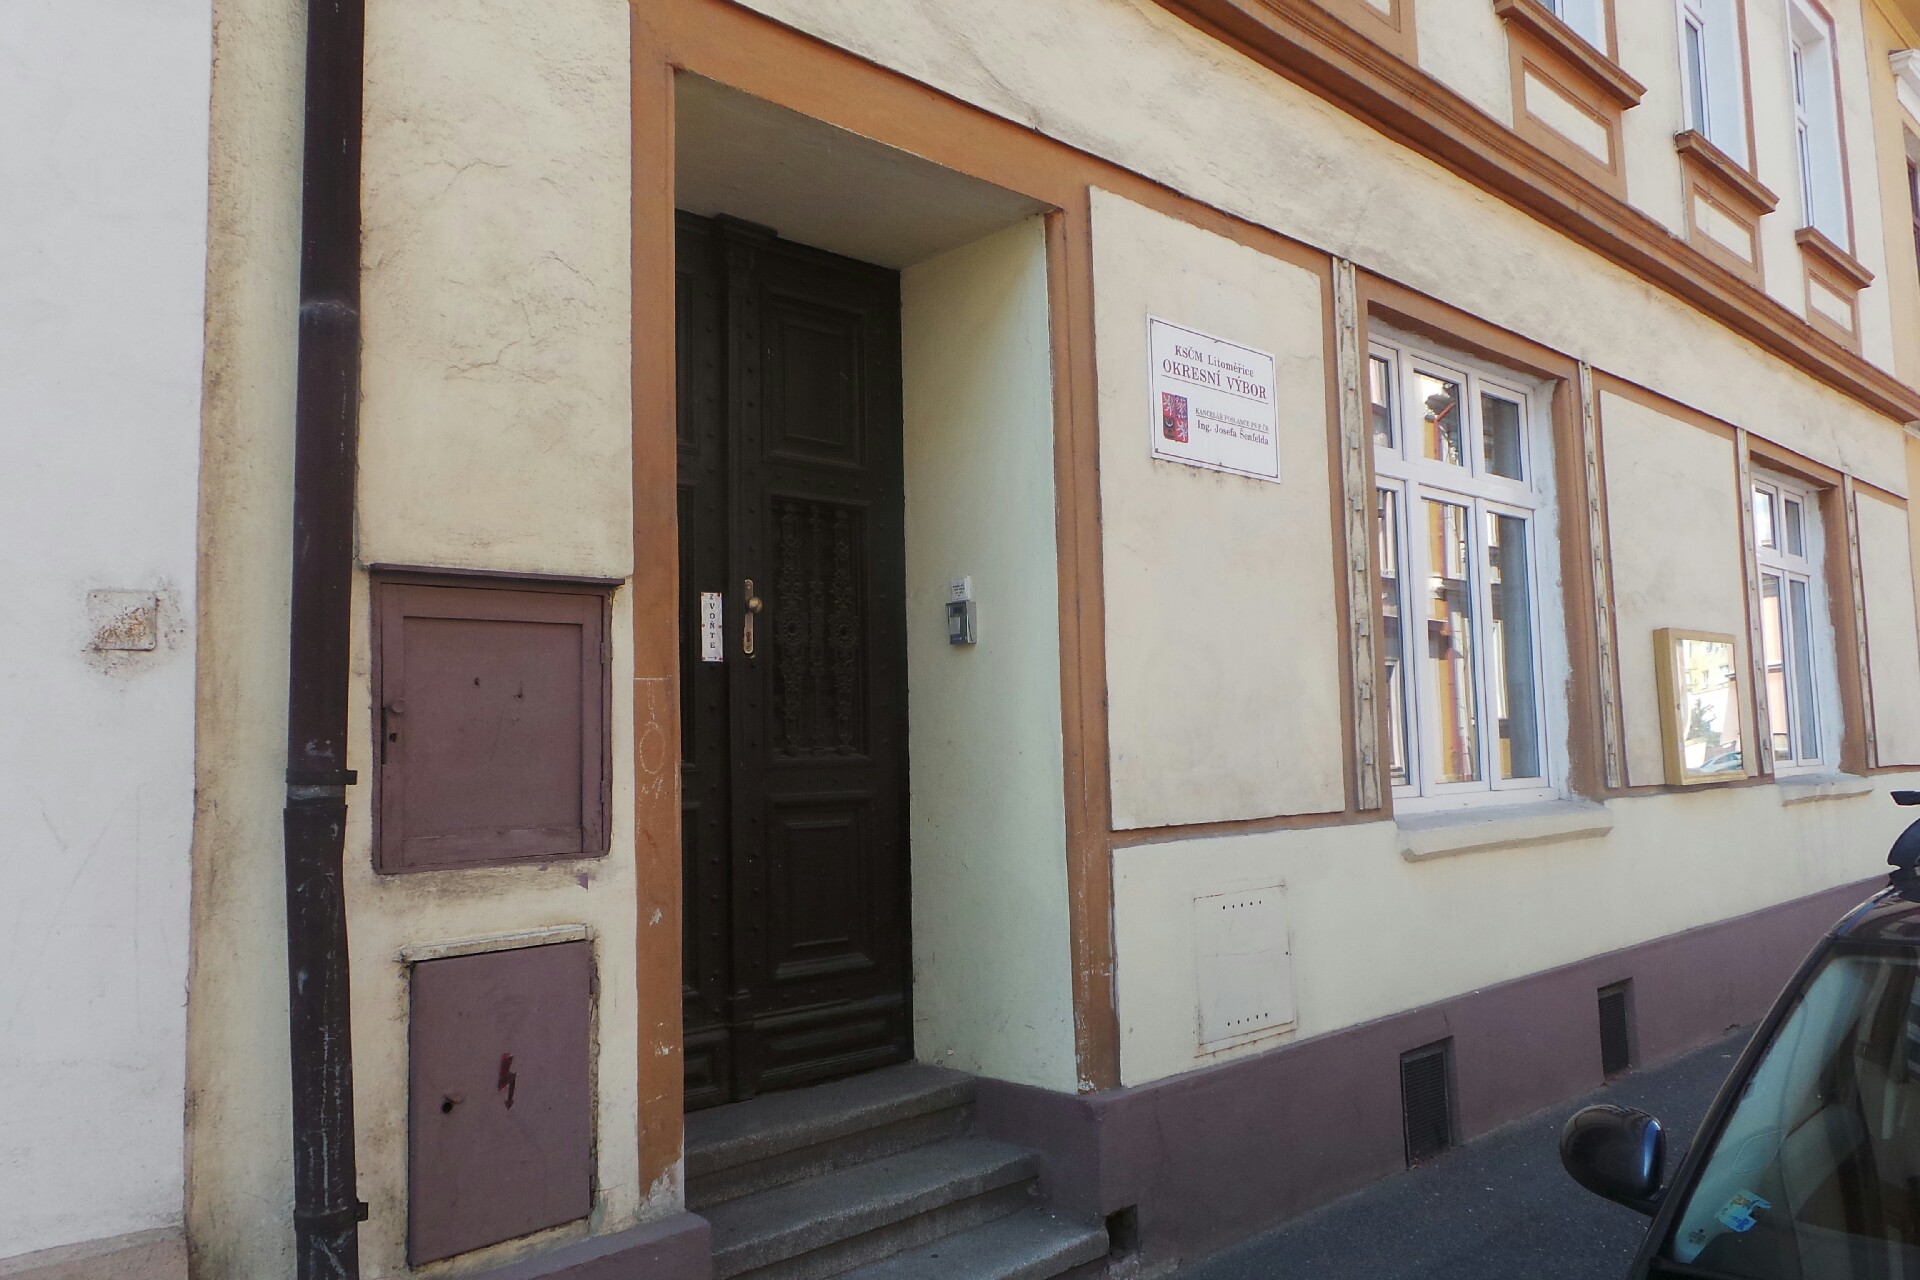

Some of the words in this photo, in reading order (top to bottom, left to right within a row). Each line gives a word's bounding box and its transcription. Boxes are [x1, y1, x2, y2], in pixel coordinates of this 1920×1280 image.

[1175, 345, 1203, 363] KSČM
[1208, 355, 1254, 377] Litoměřice
[1163, 358, 1221, 386] OKRESNÍ
[1226, 376, 1267, 399] VÝBOR
[1197, 419, 1212, 433] Ing.
[1215, 424, 1237, 437] Josefa
[1240, 428, 1269, 445] Šenfelda
